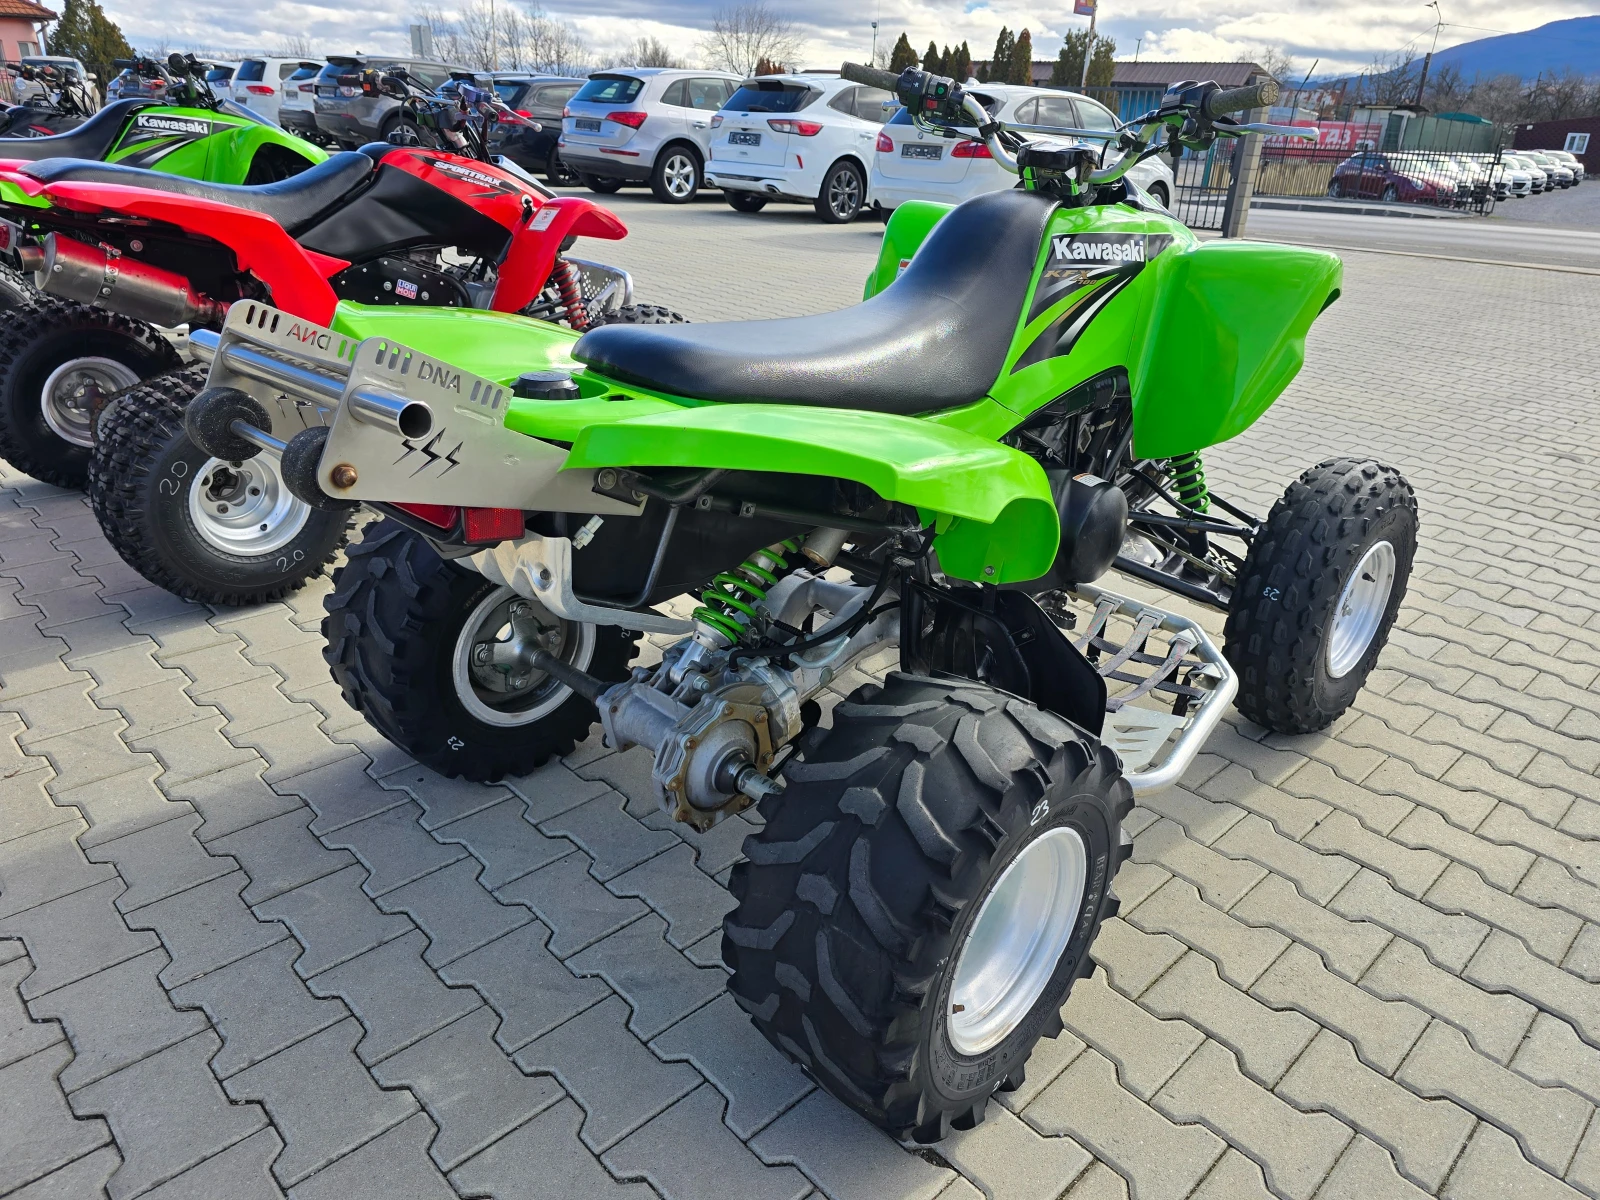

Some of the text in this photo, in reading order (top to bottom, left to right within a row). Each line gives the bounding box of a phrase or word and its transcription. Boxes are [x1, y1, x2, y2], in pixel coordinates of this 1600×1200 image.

[138, 116, 208, 134] Kawasaki
[433, 161, 501, 186] SPORTRAX
[1053, 237, 1144, 262] Kawasaki
[1044, 269, 1089, 281] KFX
[396, 287, 416, 299] MOLY
[398, 280, 417, 292] LIQUI
[417, 360, 461, 394] DNA
[159, 460, 188, 496] 20
[276, 549, 305, 573] 20
[1263, 586, 1280, 601] 23
[447, 735, 465, 751] 23
[1030, 799, 1050, 827] 23
